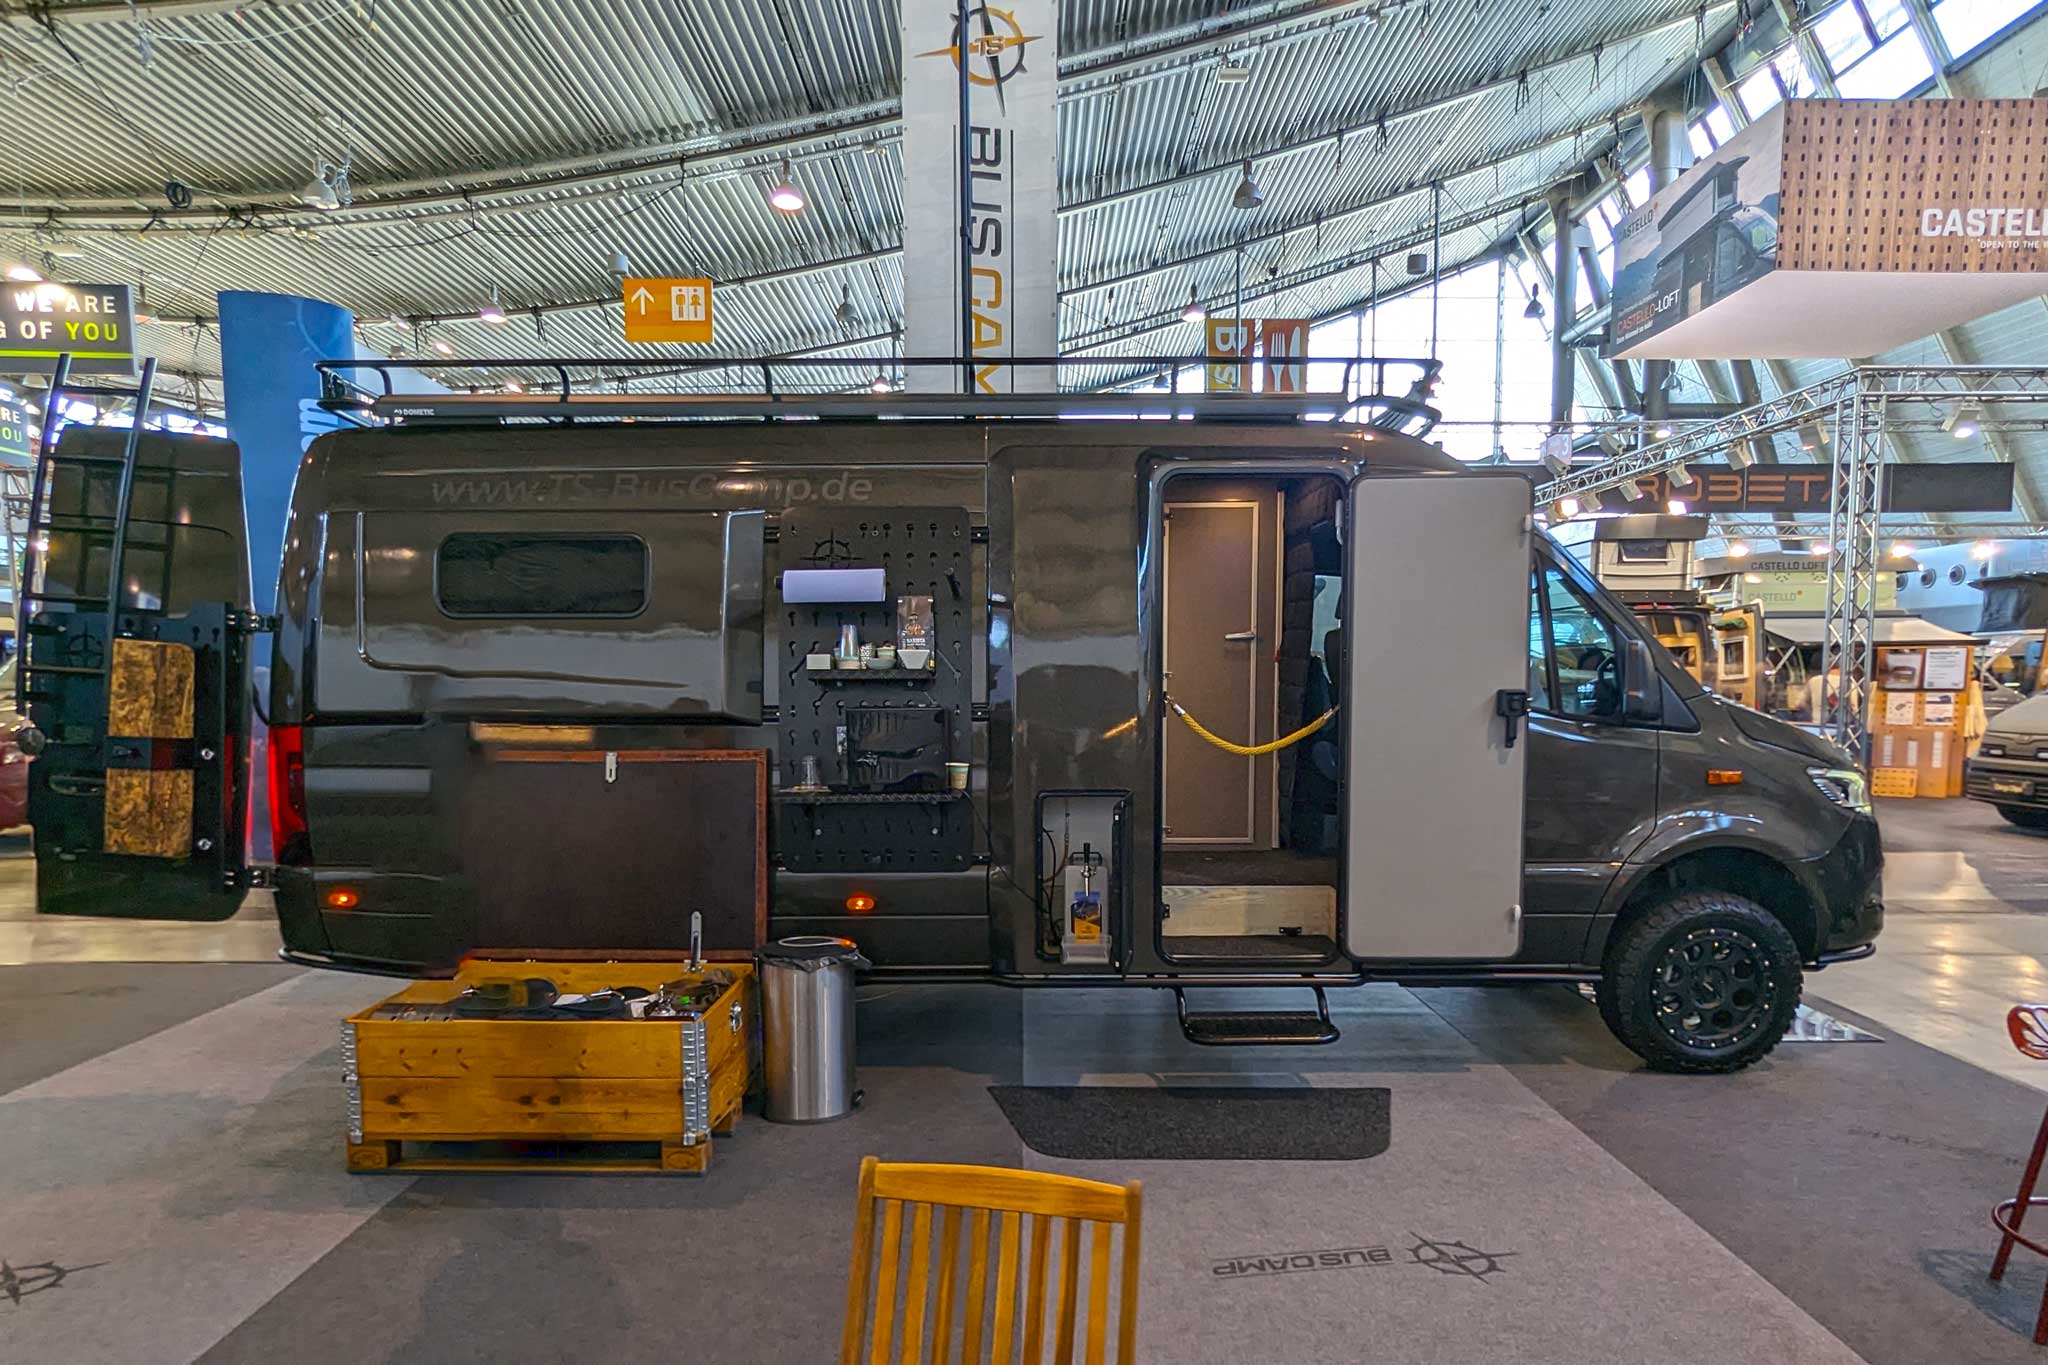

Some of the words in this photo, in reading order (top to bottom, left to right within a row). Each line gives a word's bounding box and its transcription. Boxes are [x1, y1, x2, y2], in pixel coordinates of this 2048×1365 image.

[1980, 240, 2004, 249] OPEN
[2007, 240, 2020, 249] TO
[2023, 240, 2041, 249] THE
[14, 291, 53, 313] WE
[65, 295, 117, 314] ARE
[19, 320, 53, 341] OF
[64, 320, 119, 342] YOU
[404, 408, 436, 417] DOMETIC
[431, 470, 874, 506] www.TS-BusCmp.de
[1751, 561, 1800, 571] CASTELLO
